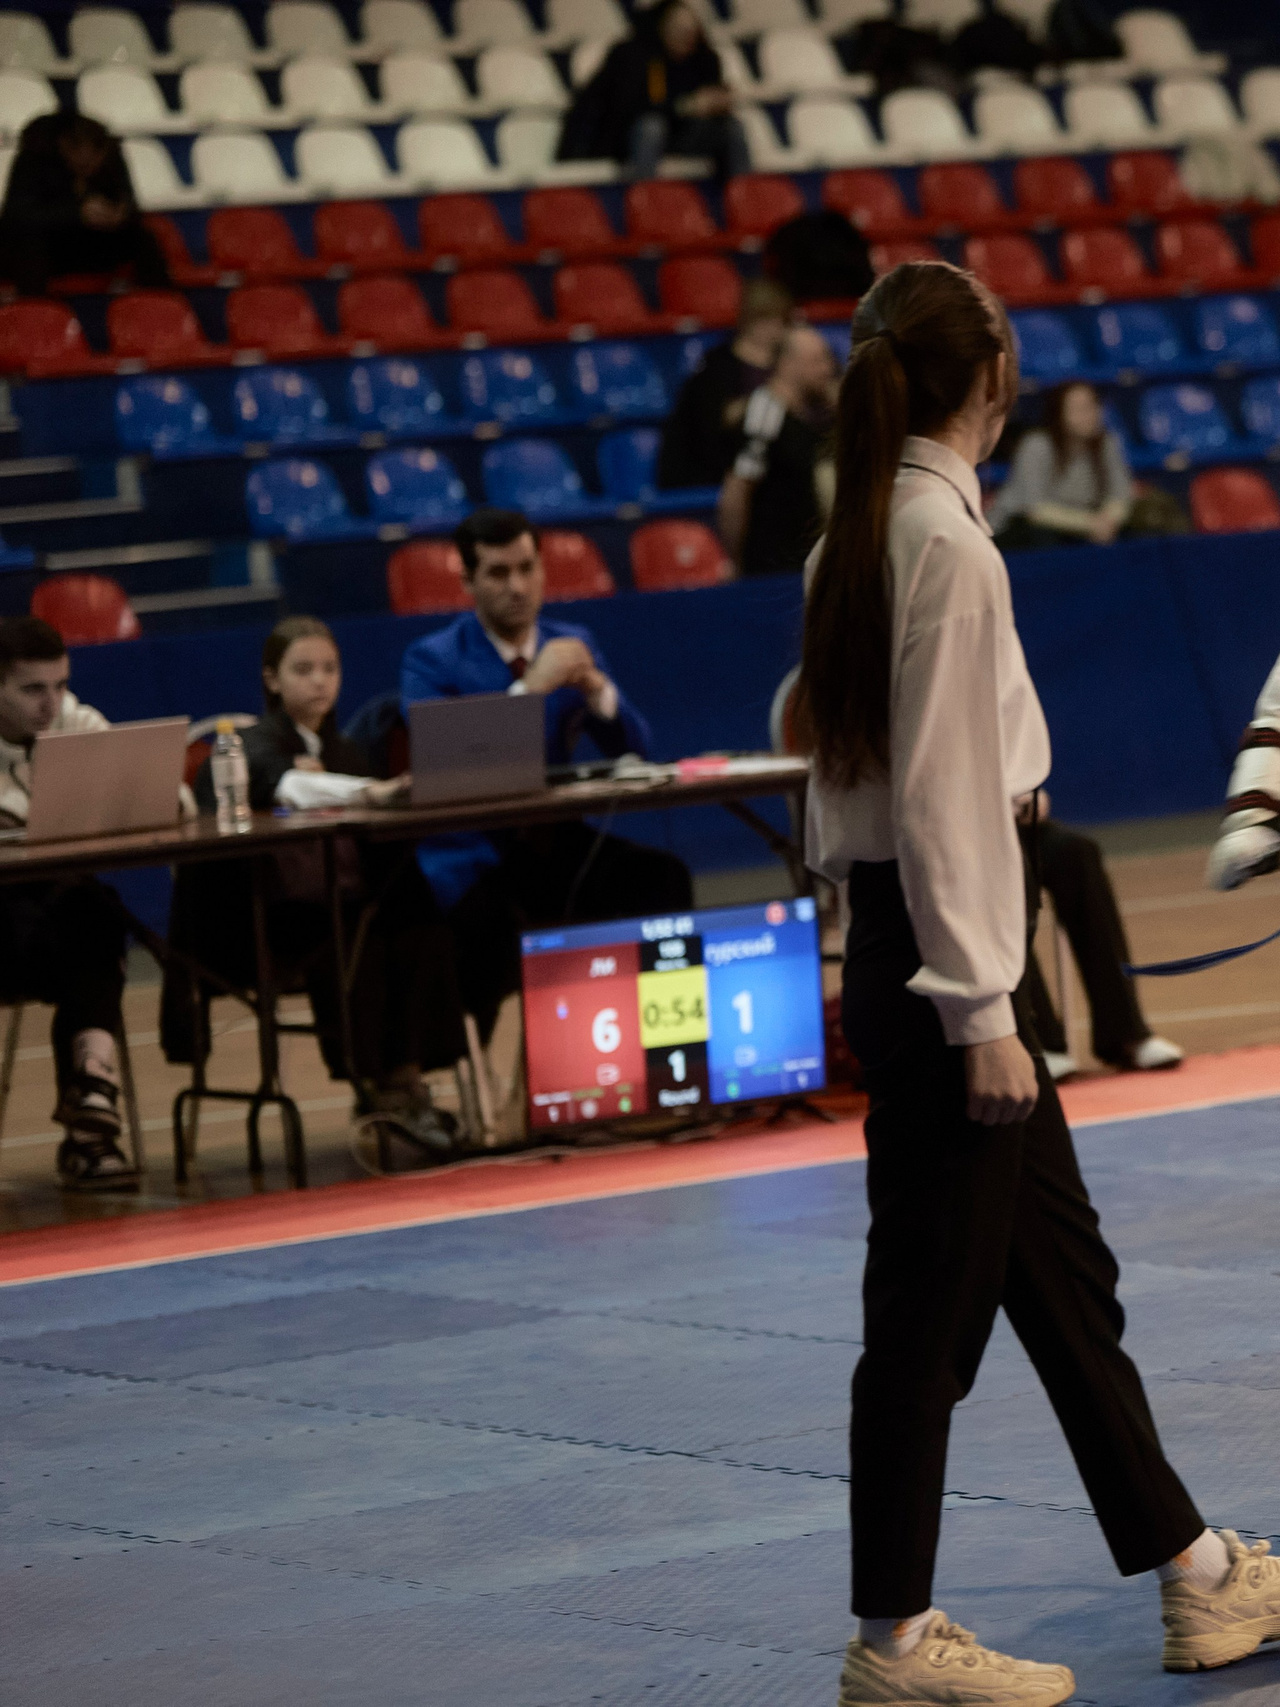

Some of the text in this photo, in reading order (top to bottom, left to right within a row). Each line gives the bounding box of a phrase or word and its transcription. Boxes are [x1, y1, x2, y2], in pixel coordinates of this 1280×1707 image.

[592, 1008, 621, 1053] 6
[643, 995, 706, 1030] 0:54
[732, 990, 753, 1034] 1
[667, 1050, 687, 1082] 1
